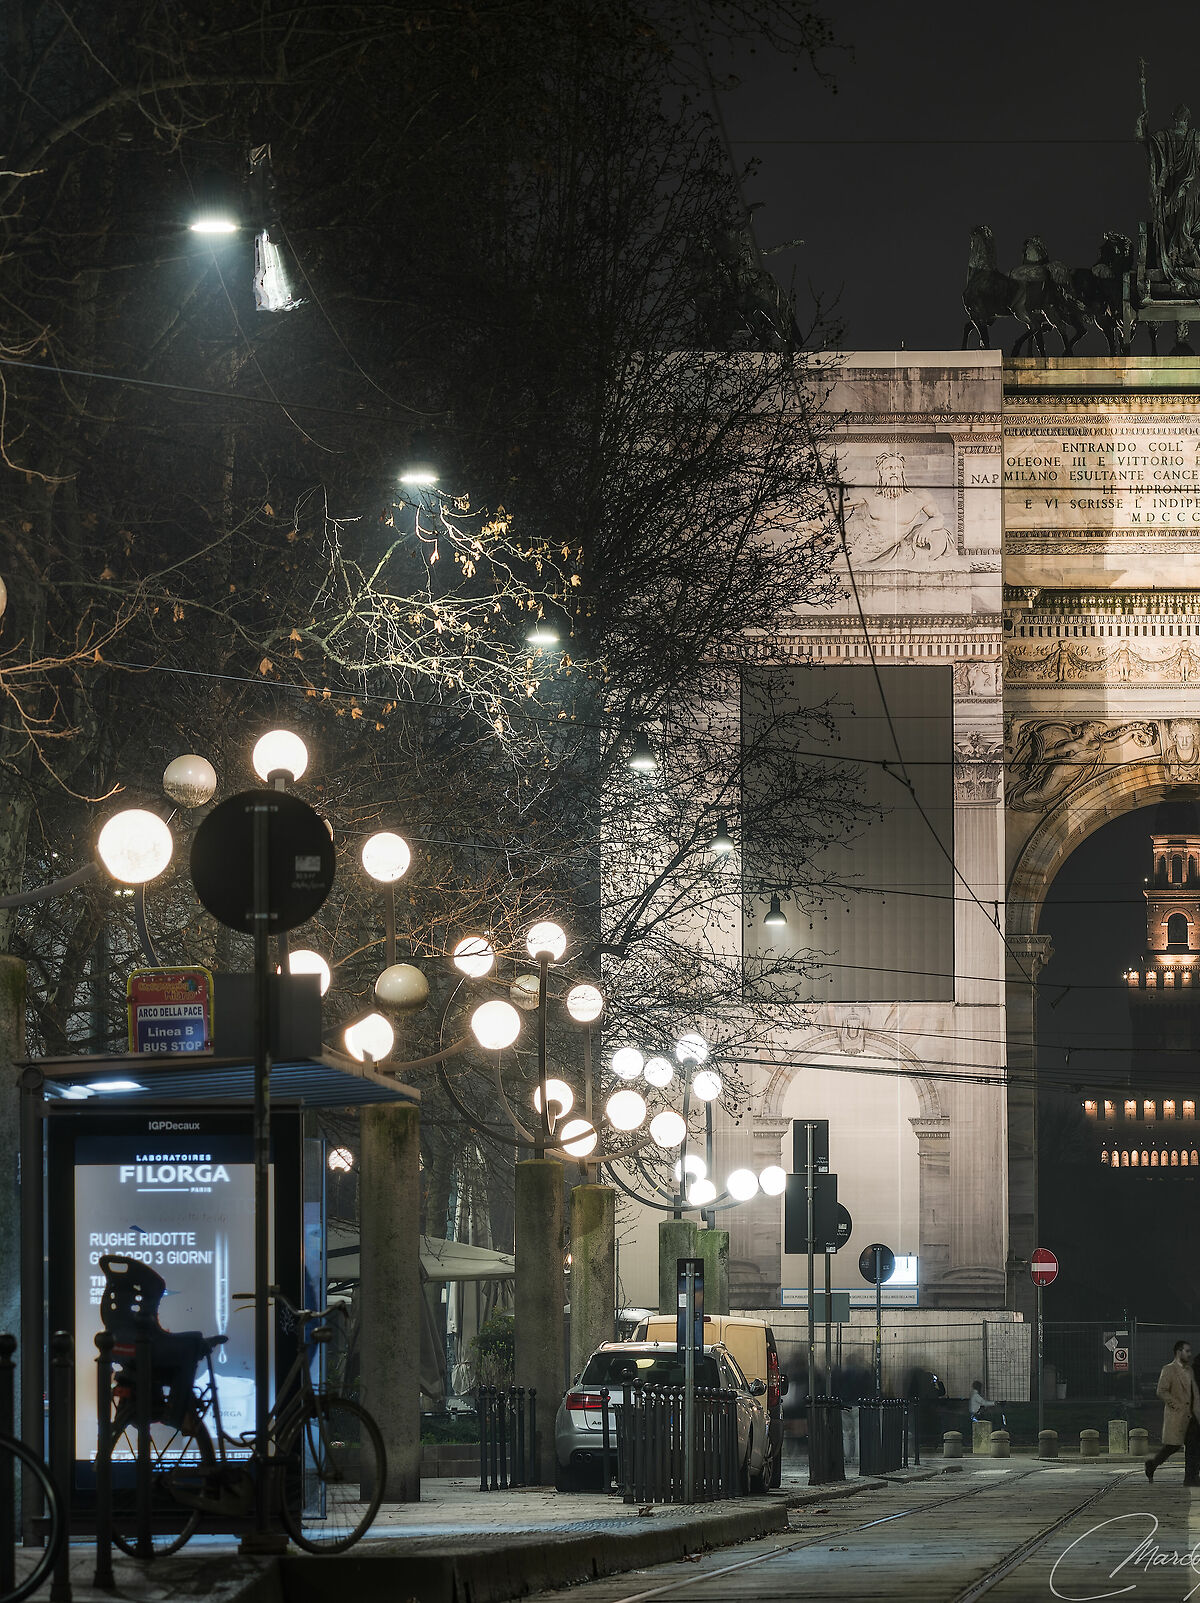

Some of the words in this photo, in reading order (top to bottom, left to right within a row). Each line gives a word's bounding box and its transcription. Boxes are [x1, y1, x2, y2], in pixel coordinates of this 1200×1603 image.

[1063, 443, 1136, 452] ENTRANDO
[1007, 457, 1060, 466] OLEONE
[1073, 457, 1086, 466] III
[1098, 456, 1105, 466] E
[1118, 456, 1184, 466] VITTORIO
[971, 474, 999, 484] NAP
[1004, 471, 1057, 481] MILANO
[1070, 471, 1144, 481] ESULTANTE
[1103, 485, 1116, 494] LE
[1129, 484, 1200, 494] IMPRONTE
[1026, 499, 1032, 509] E
[1046, 499, 1058, 509] VI
[1070, 499, 1123, 509] SCRISSE
[139, 1008, 158, 1018] ARCO
[160, 1007, 181, 1017] DELLA
[184, 1006, 202, 1015] PACE
[148, 1028, 181, 1037] Linea
[186, 1027, 193, 1036] B
[144, 1043, 167, 1052] BUS
[171, 1041, 201, 1051] STOP
[149, 1121, 200, 1130] IGPDecaux
[120, 1165, 230, 1183] FILORGA
[90, 1233, 135, 1246] RUGHE
[140, 1232, 196, 1246] RIDOTTE
[155, 1251, 164, 1264] 3
